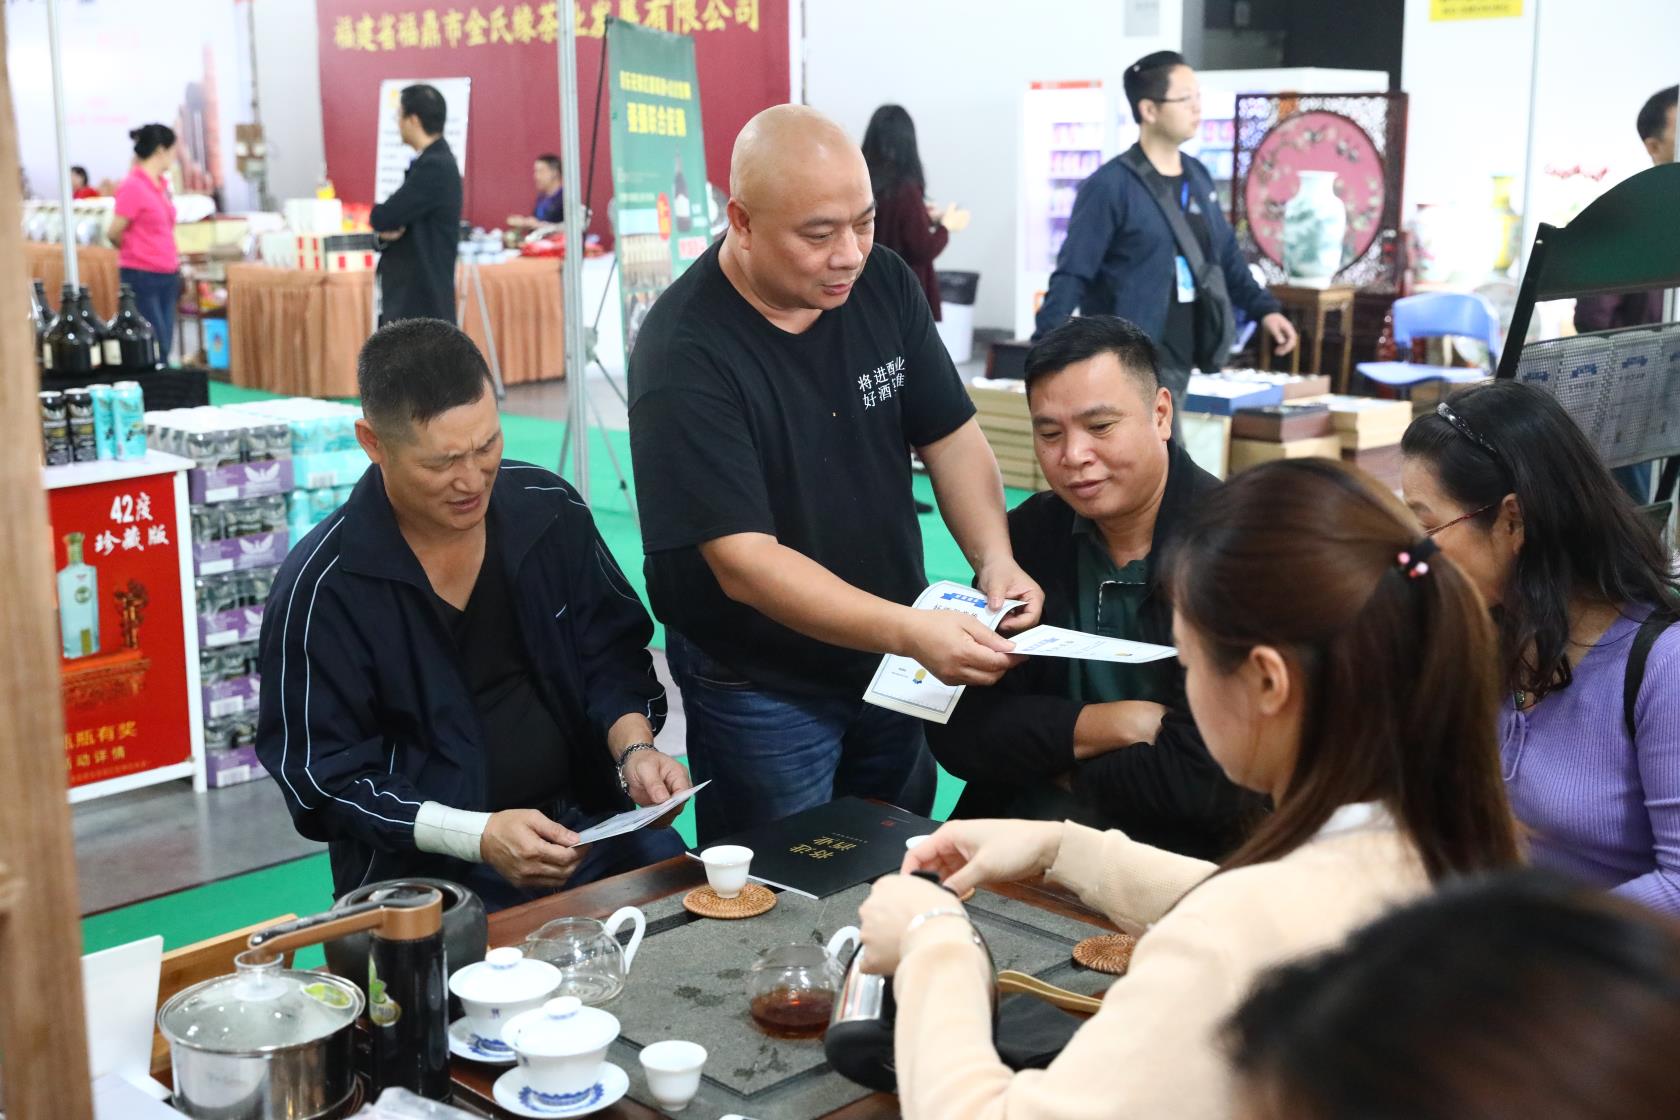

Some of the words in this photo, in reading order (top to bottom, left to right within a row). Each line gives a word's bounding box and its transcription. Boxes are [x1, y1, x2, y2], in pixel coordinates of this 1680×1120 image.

[110, 491, 154, 524] 42度
[94, 524, 170, 556] 珍藏版
